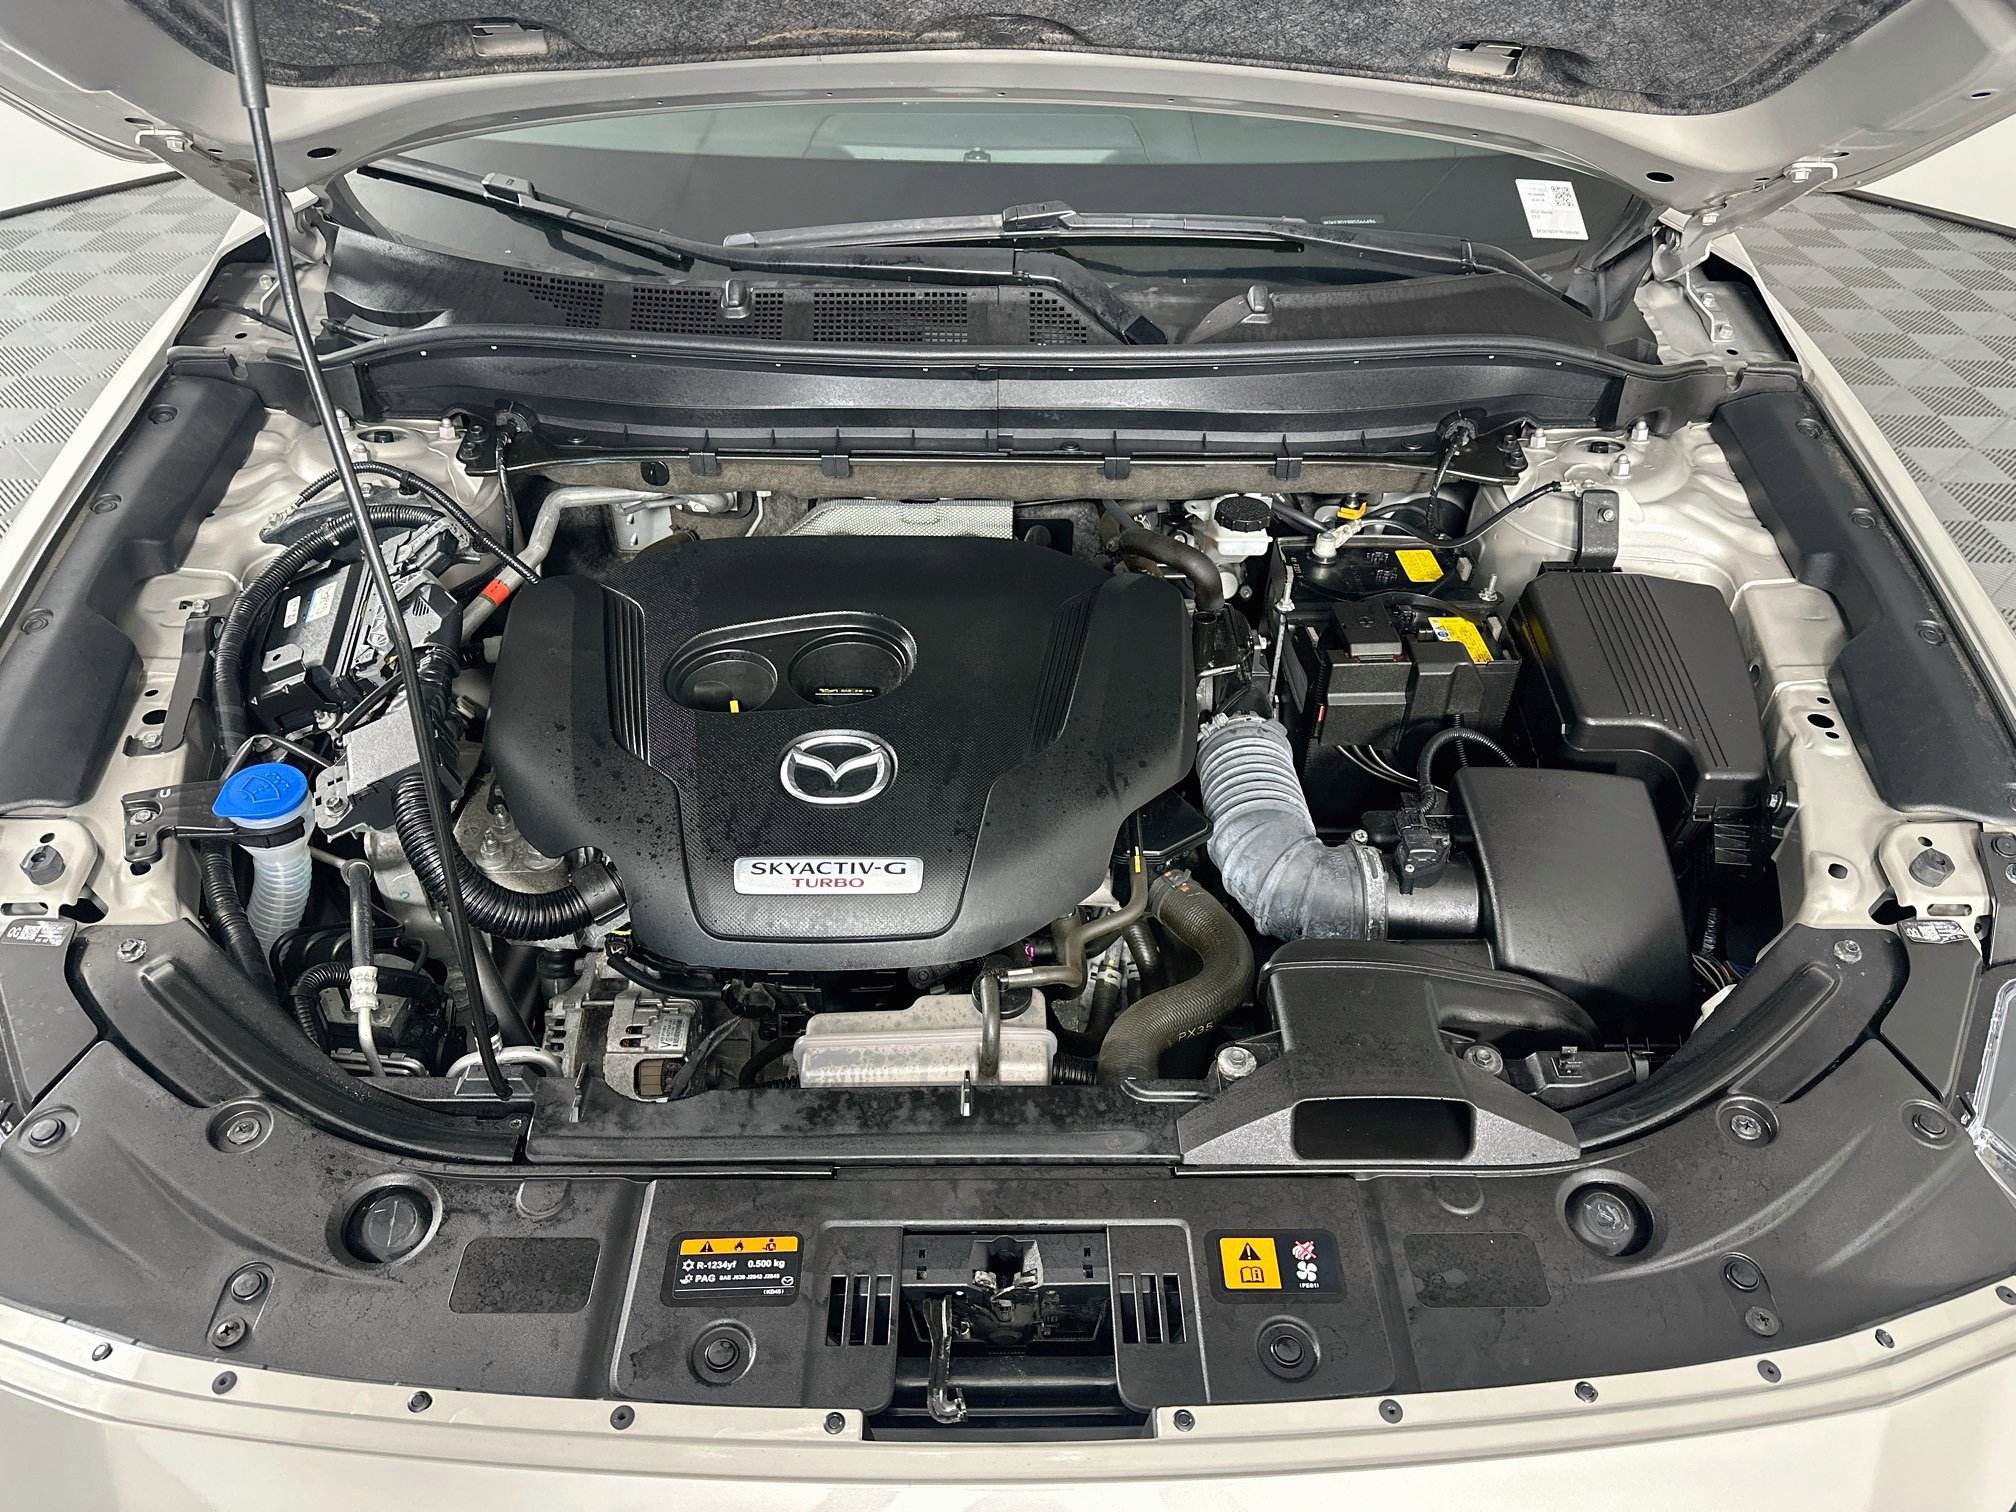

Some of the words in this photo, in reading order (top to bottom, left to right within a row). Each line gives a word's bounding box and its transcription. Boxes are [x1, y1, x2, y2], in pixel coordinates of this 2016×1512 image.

[750, 861, 907, 875] SKYACTIV-G
[792, 877, 865, 888] TURBO
[1178, 1021, 1213, 1041] PX35
[696, 1260, 737, 1270] R-1234yf
[747, 1260, 772, 1268] 0.500
[773, 1259, 786, 1268] kg
[694, 1274, 716, 1283] PAG
